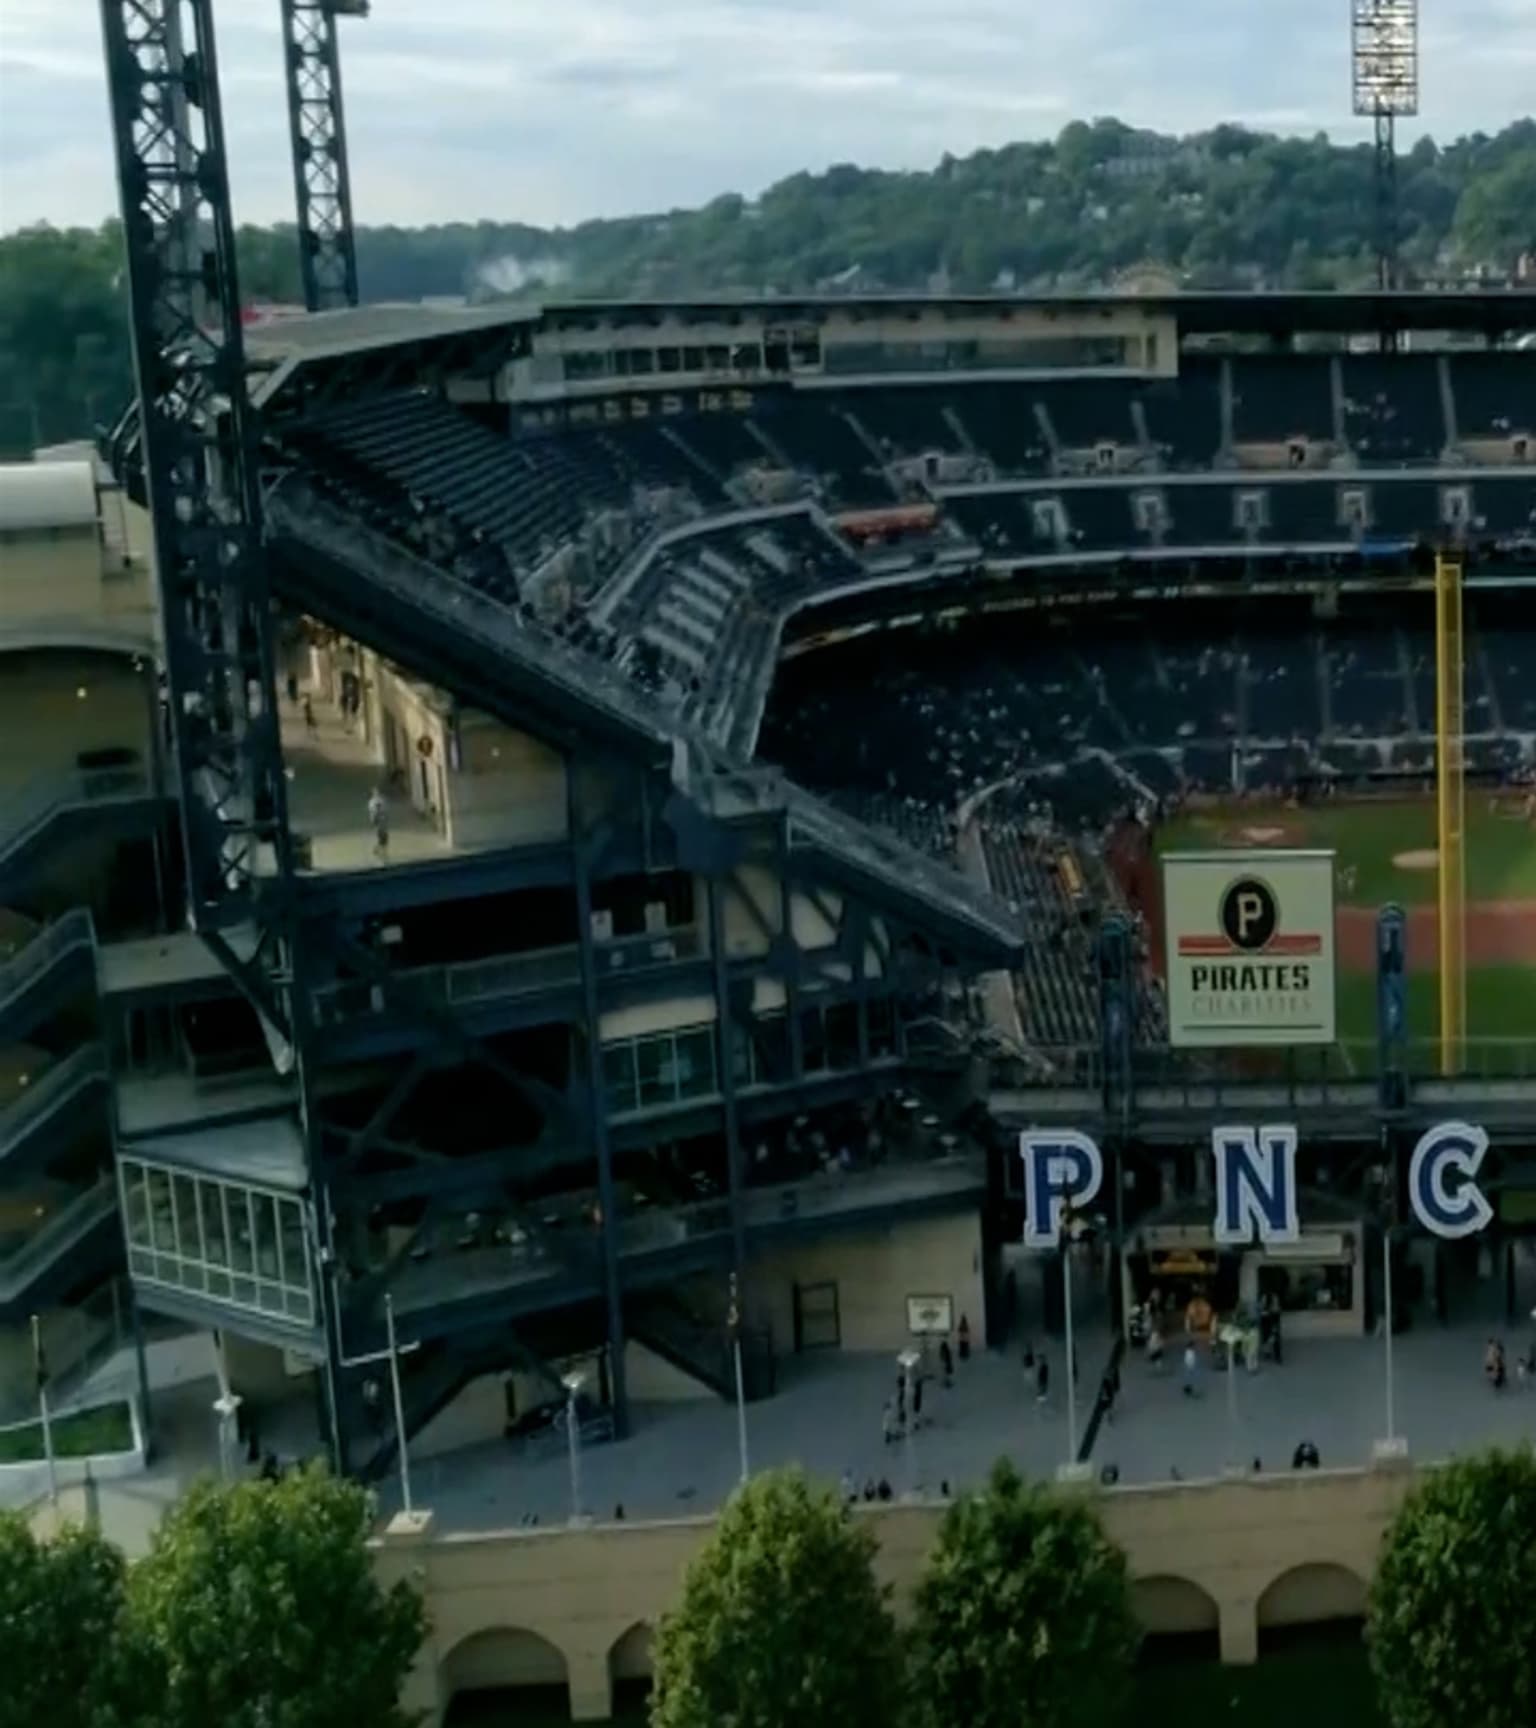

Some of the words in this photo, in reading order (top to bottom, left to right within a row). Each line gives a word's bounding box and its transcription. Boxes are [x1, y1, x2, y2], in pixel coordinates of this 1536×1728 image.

[1236, 892, 1264, 940] P
[1190, 964, 1310, 992] PIRATES
[1021, 1121, 1494, 1246] PNC
